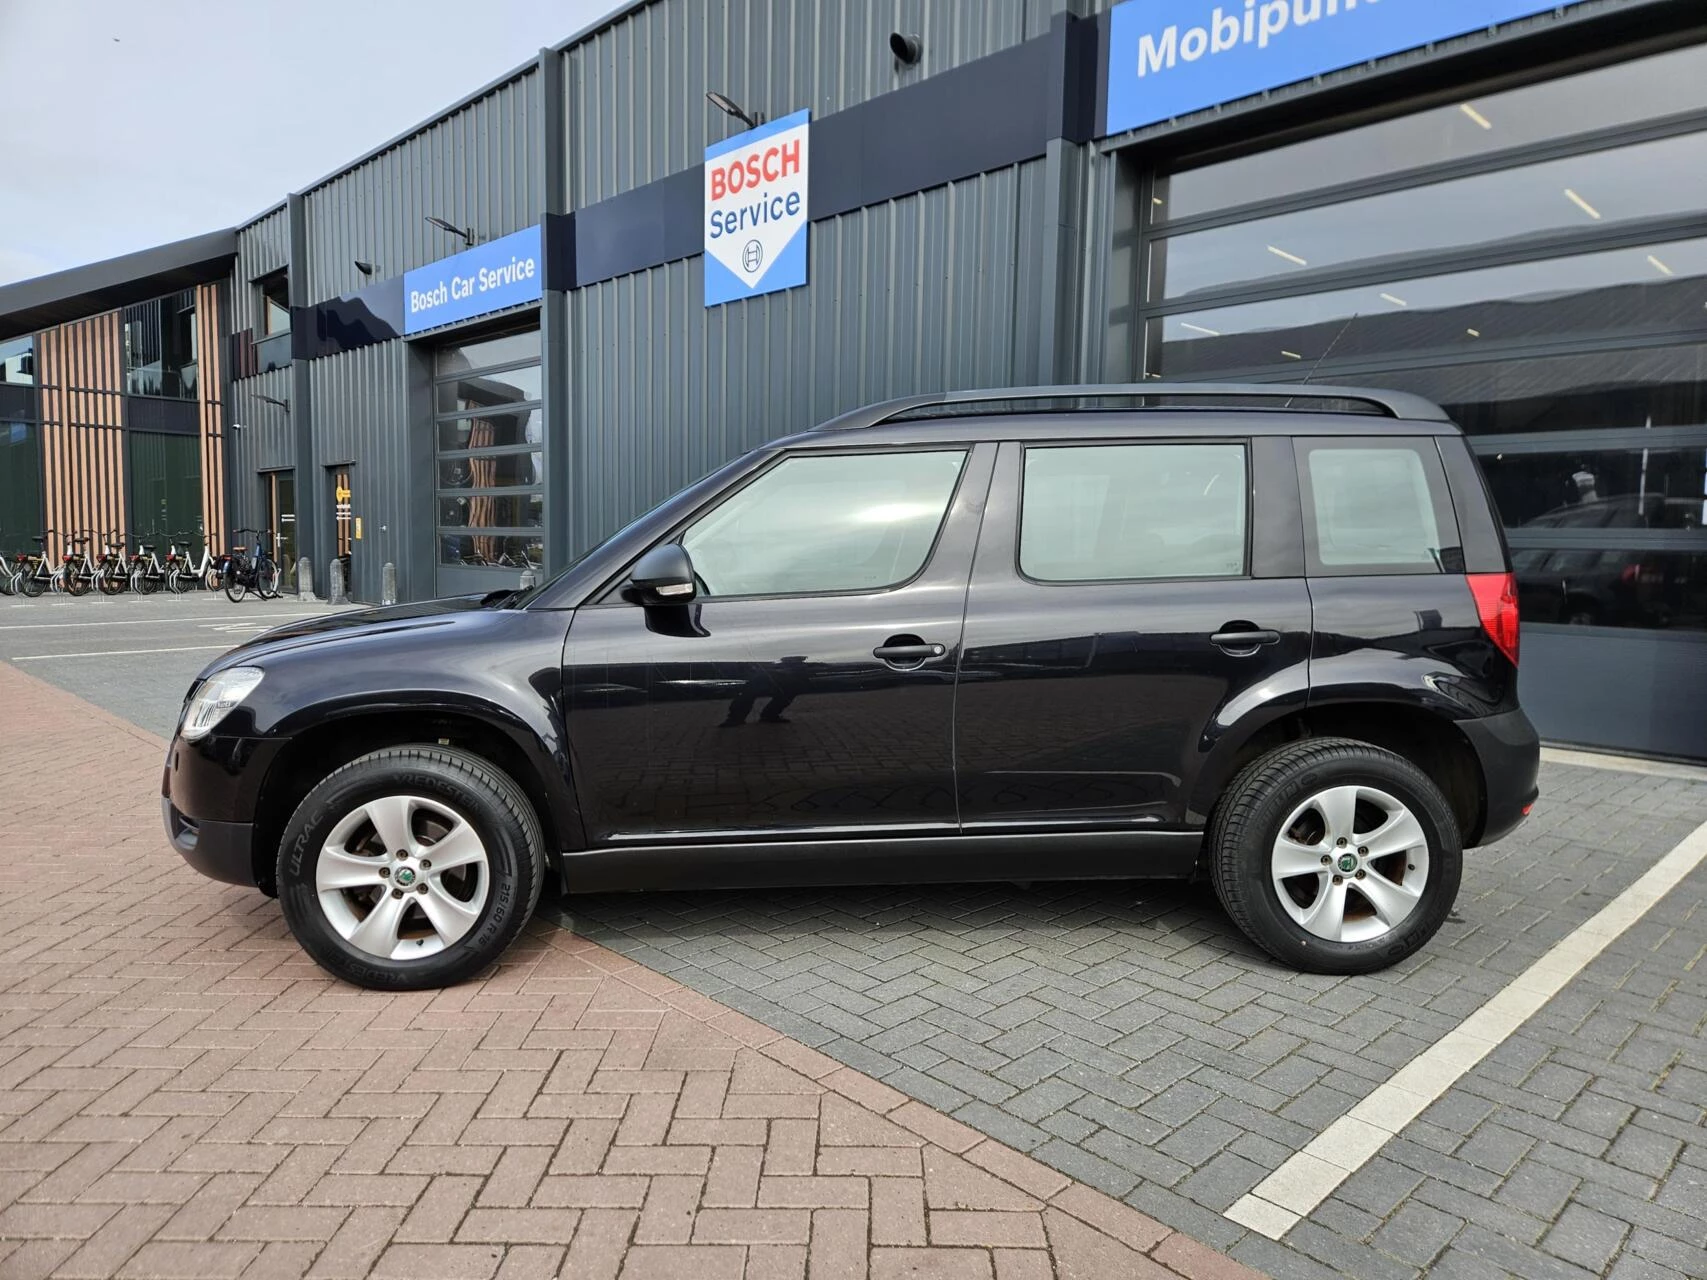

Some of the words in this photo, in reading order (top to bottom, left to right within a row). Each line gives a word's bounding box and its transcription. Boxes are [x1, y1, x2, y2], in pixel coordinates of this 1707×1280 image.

[711, 139, 800, 201] BOSCH
[710, 190, 800, 239] Service
[410, 280, 448, 313] Bosch
[450, 276, 476, 300] Car
[478, 256, 535, 292] Service
[289, 809, 323, 877] ULTRAC
[487, 922, 497, 935] R
